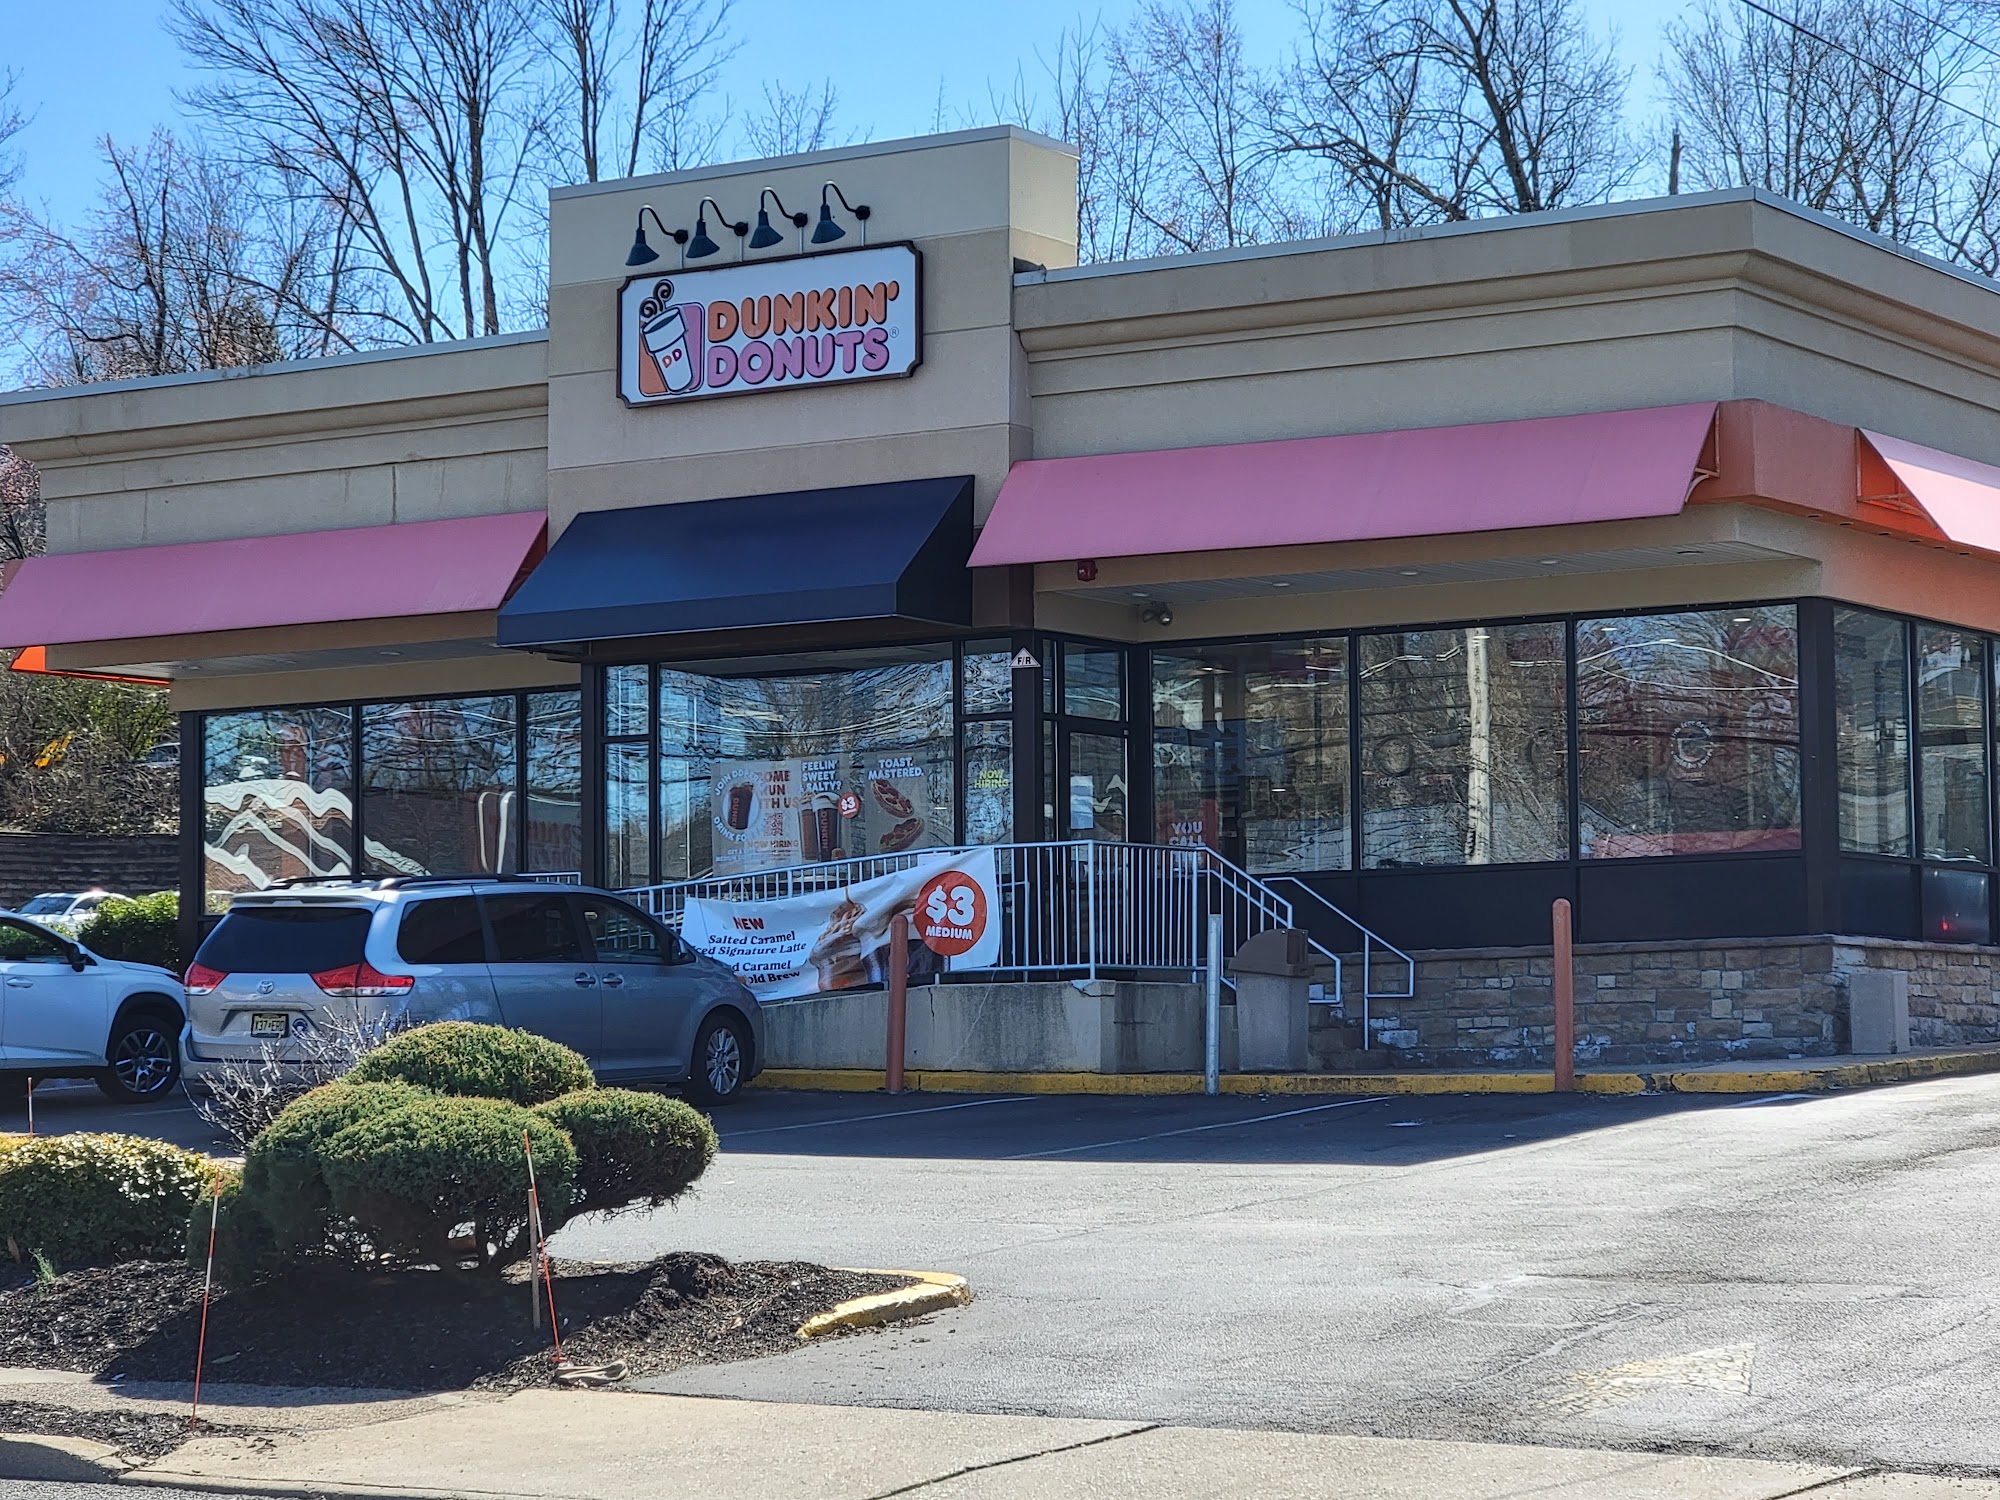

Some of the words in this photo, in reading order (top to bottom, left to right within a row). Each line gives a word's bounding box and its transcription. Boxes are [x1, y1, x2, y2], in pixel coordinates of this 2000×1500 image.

[707, 280, 900, 343] DUNKIN'
[707, 327, 890, 388] DONUTS
[1017, 656, 1031, 665] F/R
[802, 760, 839, 771] FEELIN'
[878, 757, 914, 769] TOAST.
[802, 771, 835, 782] SWEET
[868, 767, 924, 780] MASTERED.
[979, 769, 1005, 779] NOW
[714, 774, 732, 796] JOIN
[806, 781, 842, 792] SALTY?
[974, 778, 1009, 789] HIRING
[841, 796, 856, 811] $3
[713, 816, 735, 841] DRINK
[1171, 821, 1203, 835] YOU
[770, 840, 799, 848] HIRING
[1169, 835, 1206, 847] CALL
[925, 884, 975, 926] $3
[733, 916, 764, 930] NEW
[709, 934, 748, 945] Salted
[750, 930, 796, 945] Caramel
[925, 925, 973, 940] MEDIUM
[717, 946, 777, 957] Signature
[779, 942, 807, 954] Latte
[742, 960, 792, 972] Caramel
[767, 970, 800, 982] Brew
